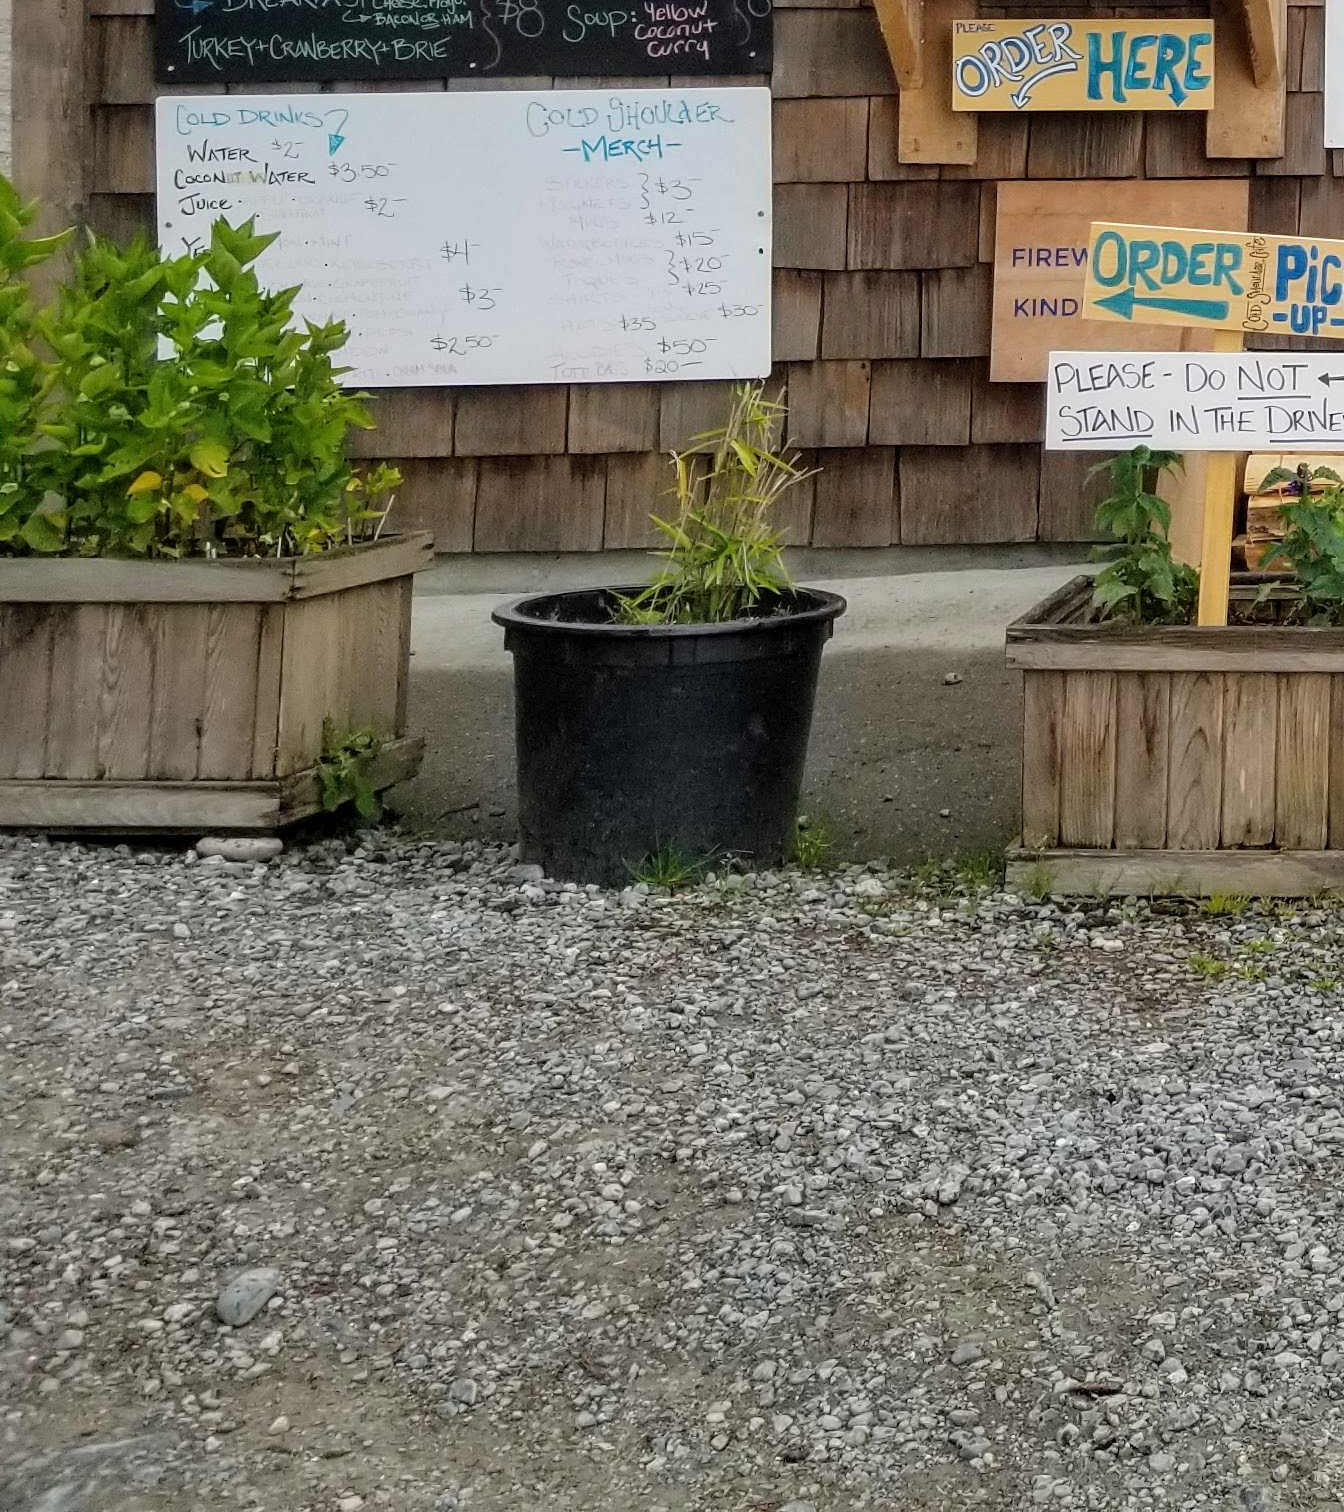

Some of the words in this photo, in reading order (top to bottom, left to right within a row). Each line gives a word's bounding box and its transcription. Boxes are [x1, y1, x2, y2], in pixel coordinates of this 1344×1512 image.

[644, 0, 708, 22] Yellow
[956, 23, 995, 33] PLEASE
[956, 23, 1084, 97] ORDER
[1086, 31, 1212, 107] HERE
[177, 105, 230, 134] COLD
[237, 106, 323, 128] DRINKS
[527, 101, 599, 138] COLD
[187, 139, 257, 163] WATER
[250, 164, 315, 186] WATER
[1092, 231, 1244, 296] ORDER
[1014, 297, 1082, 317] KIND
[1186, 363, 1225, 393] DO
[1238, 360, 1309, 391] NOT
[1062, 405, 1154, 436] STAND
[1169, 405, 1200, 434] IN
[1203, 407, 1255, 433] THE
